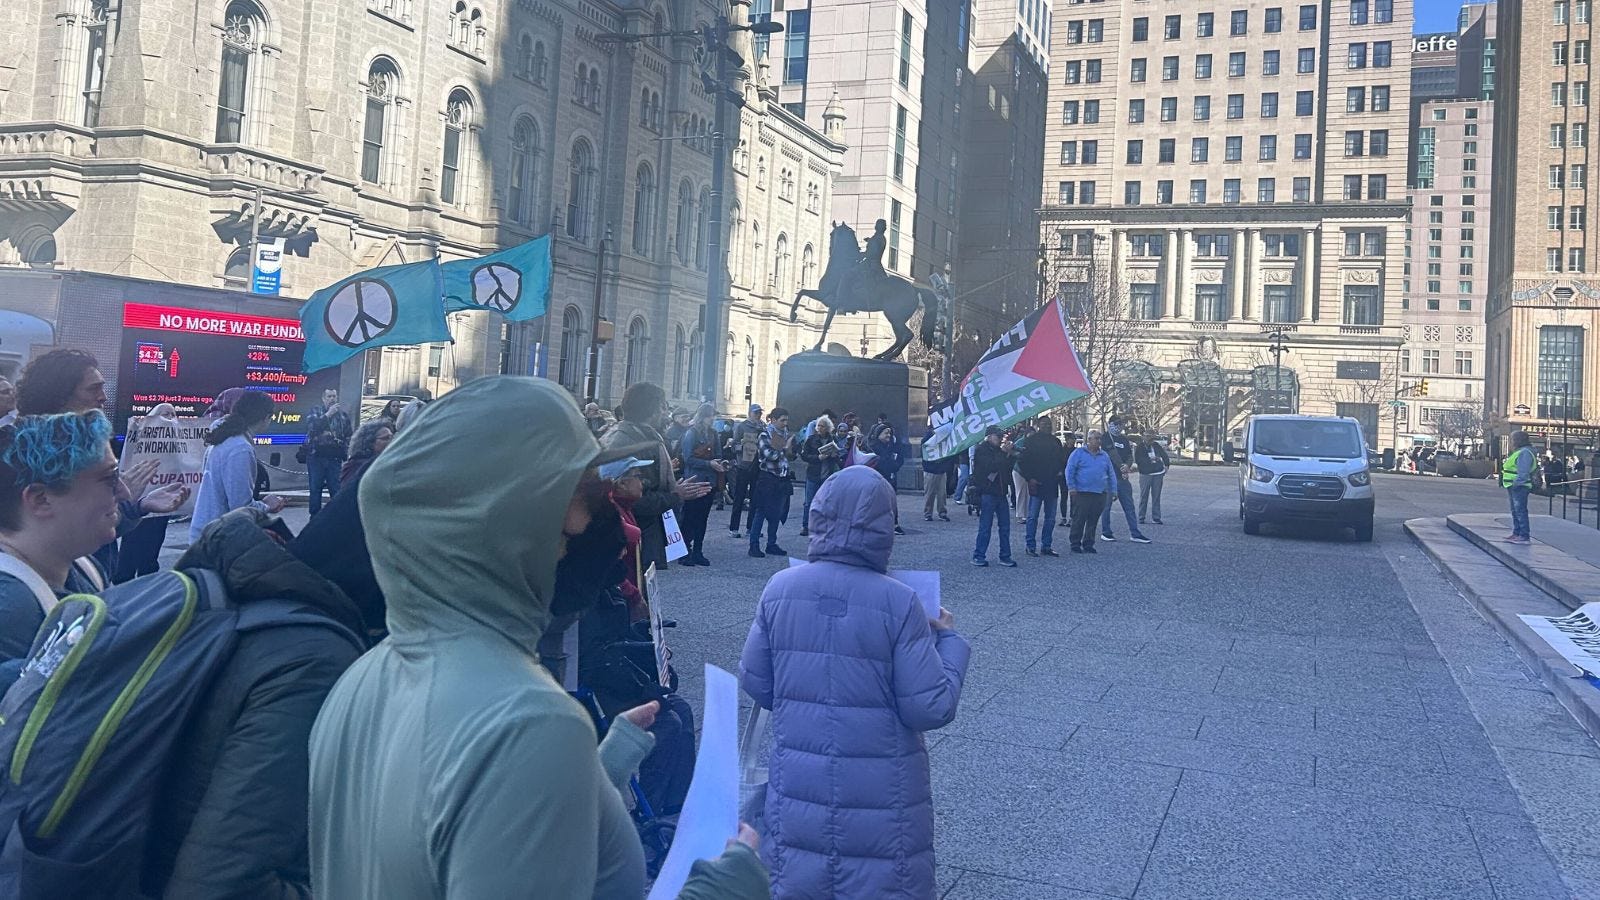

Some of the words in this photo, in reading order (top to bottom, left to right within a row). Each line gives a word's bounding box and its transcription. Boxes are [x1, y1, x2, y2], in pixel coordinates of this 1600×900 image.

[1411, 35, 1457, 52] Jeffe
[160, 314, 183, 328] NO
[186, 316, 227, 332] MORE
[230, 320, 261, 336] WAR
[138, 350, 163, 359] $4.75
[247, 352, 270, 361] +28%
[246, 371, 307, 385] +$3,400/family
[165, 395, 177, 403] just
[270, 393, 296, 402] ILLION
[282, 414, 301, 424] year
[142, 426, 177, 439] RISTIAN
[1521, 425, 1559, 434] PRETZEL
[258, 437, 272, 445] WAR
[150, 472, 204, 486] CUPATIO
